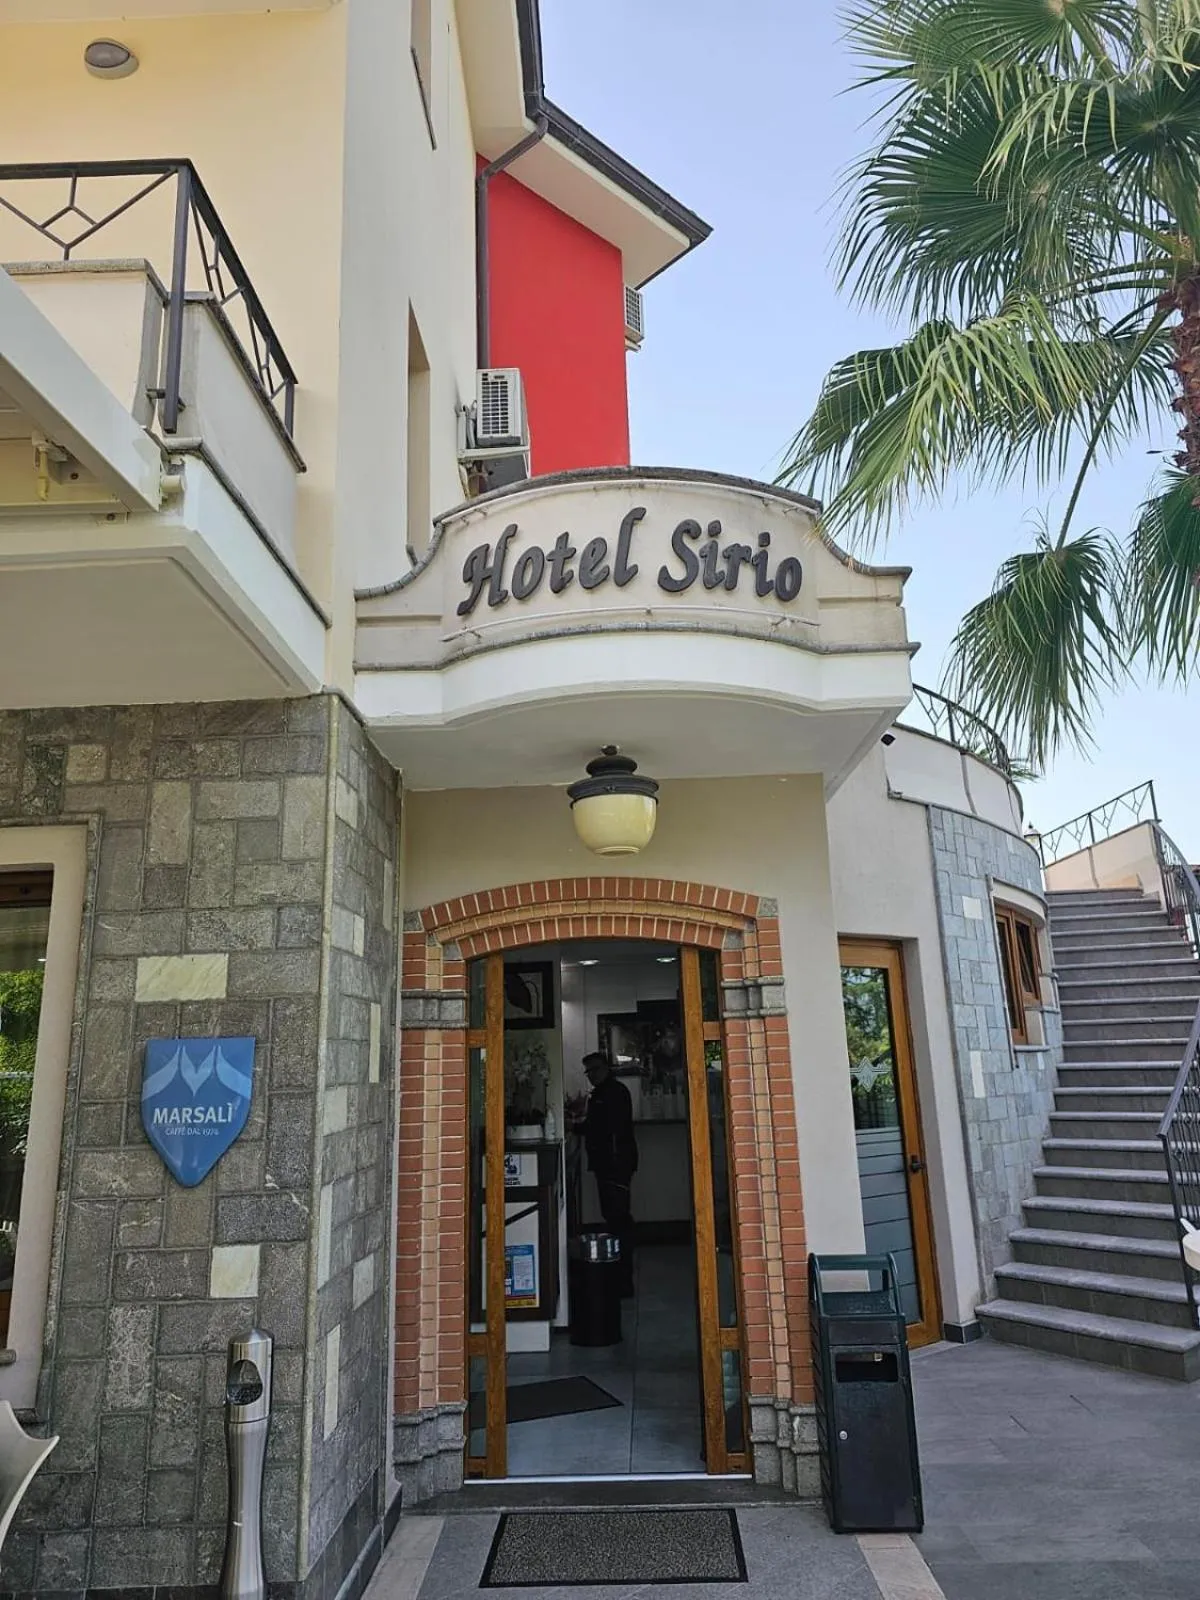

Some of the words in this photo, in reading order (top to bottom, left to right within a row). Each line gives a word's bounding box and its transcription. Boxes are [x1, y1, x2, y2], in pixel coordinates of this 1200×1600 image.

[457, 507, 647, 615] Hotel
[657, 519, 803, 602] Sirio
[153, 1102, 233, 1124] MARSALÌ
